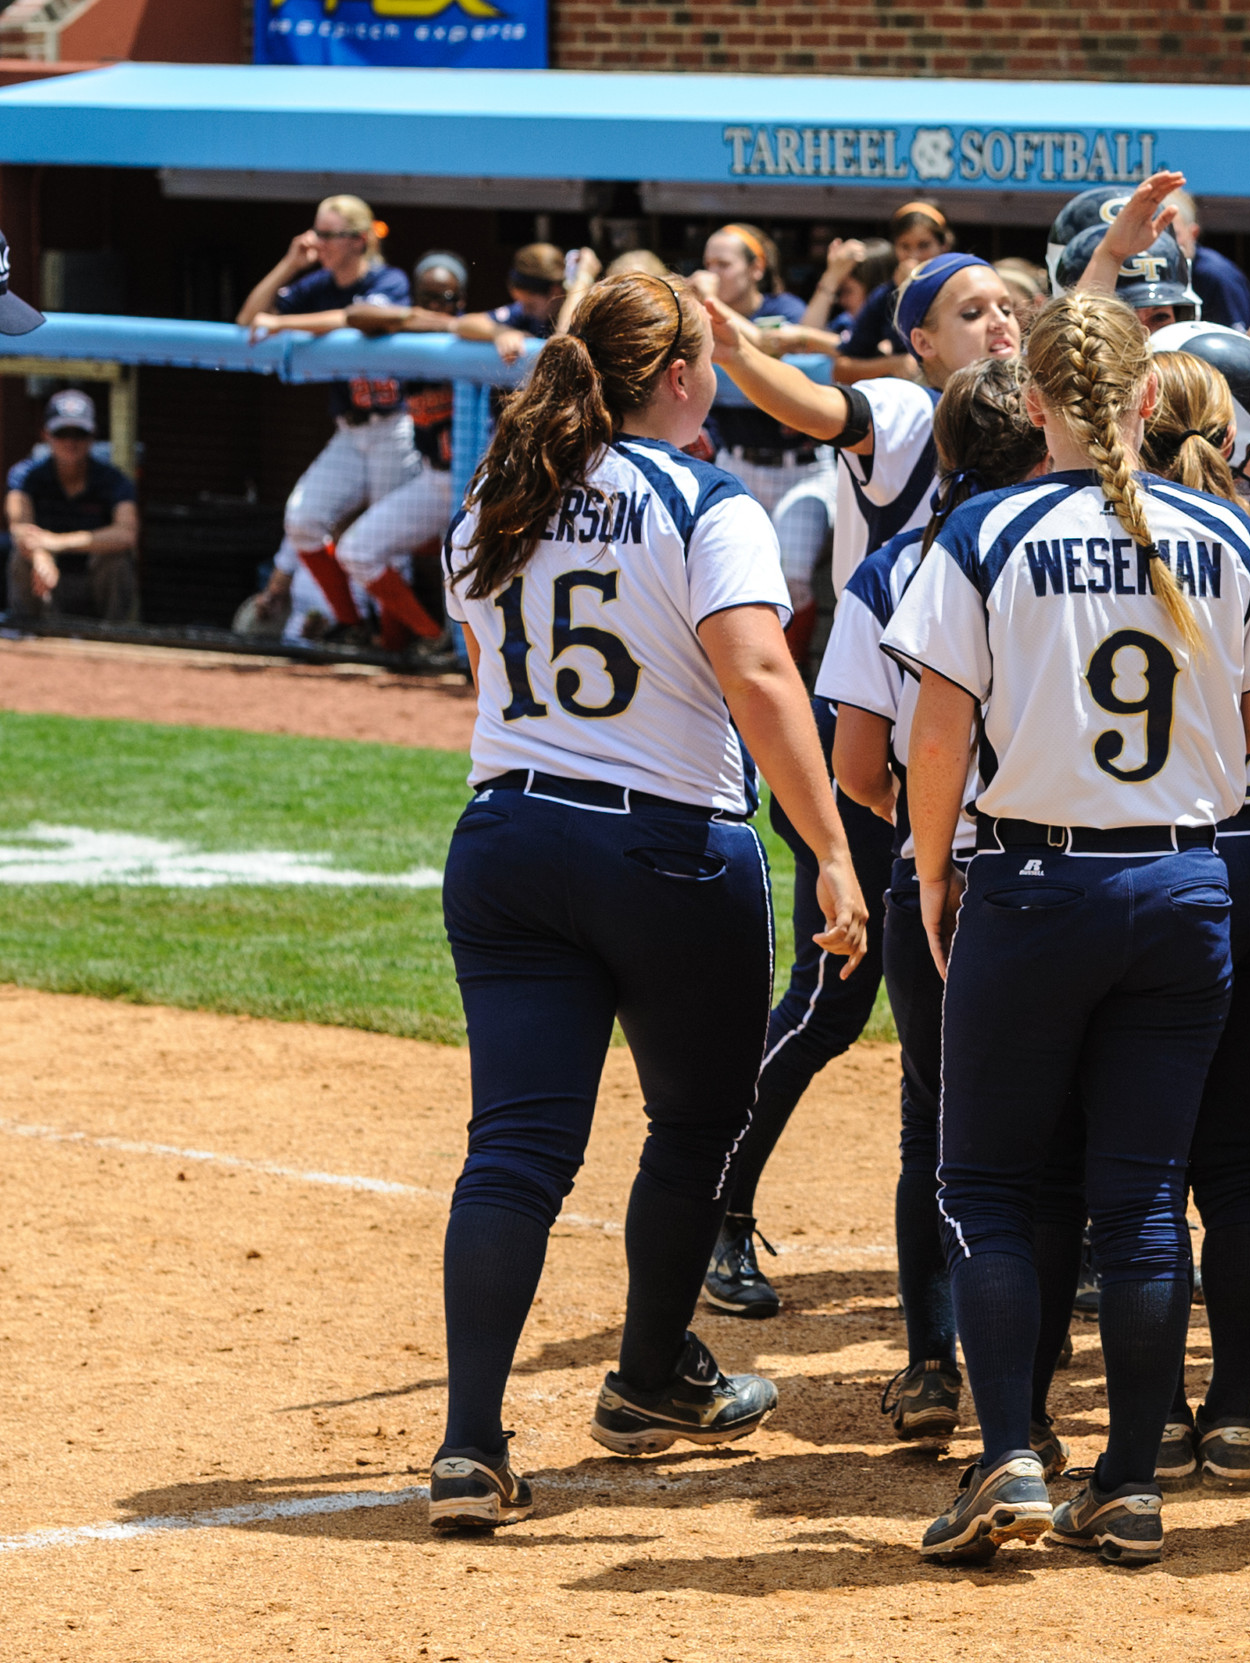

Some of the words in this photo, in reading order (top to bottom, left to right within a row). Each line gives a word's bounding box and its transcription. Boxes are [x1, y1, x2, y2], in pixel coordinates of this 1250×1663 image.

[723, 126, 908, 179] TARHEEL
[959, 130, 1158, 183] SOFTBALL
[1024, 537, 1222, 598] WESEMAN
[494, 569, 643, 724] 15
[1083, 626, 1183, 785] 9
